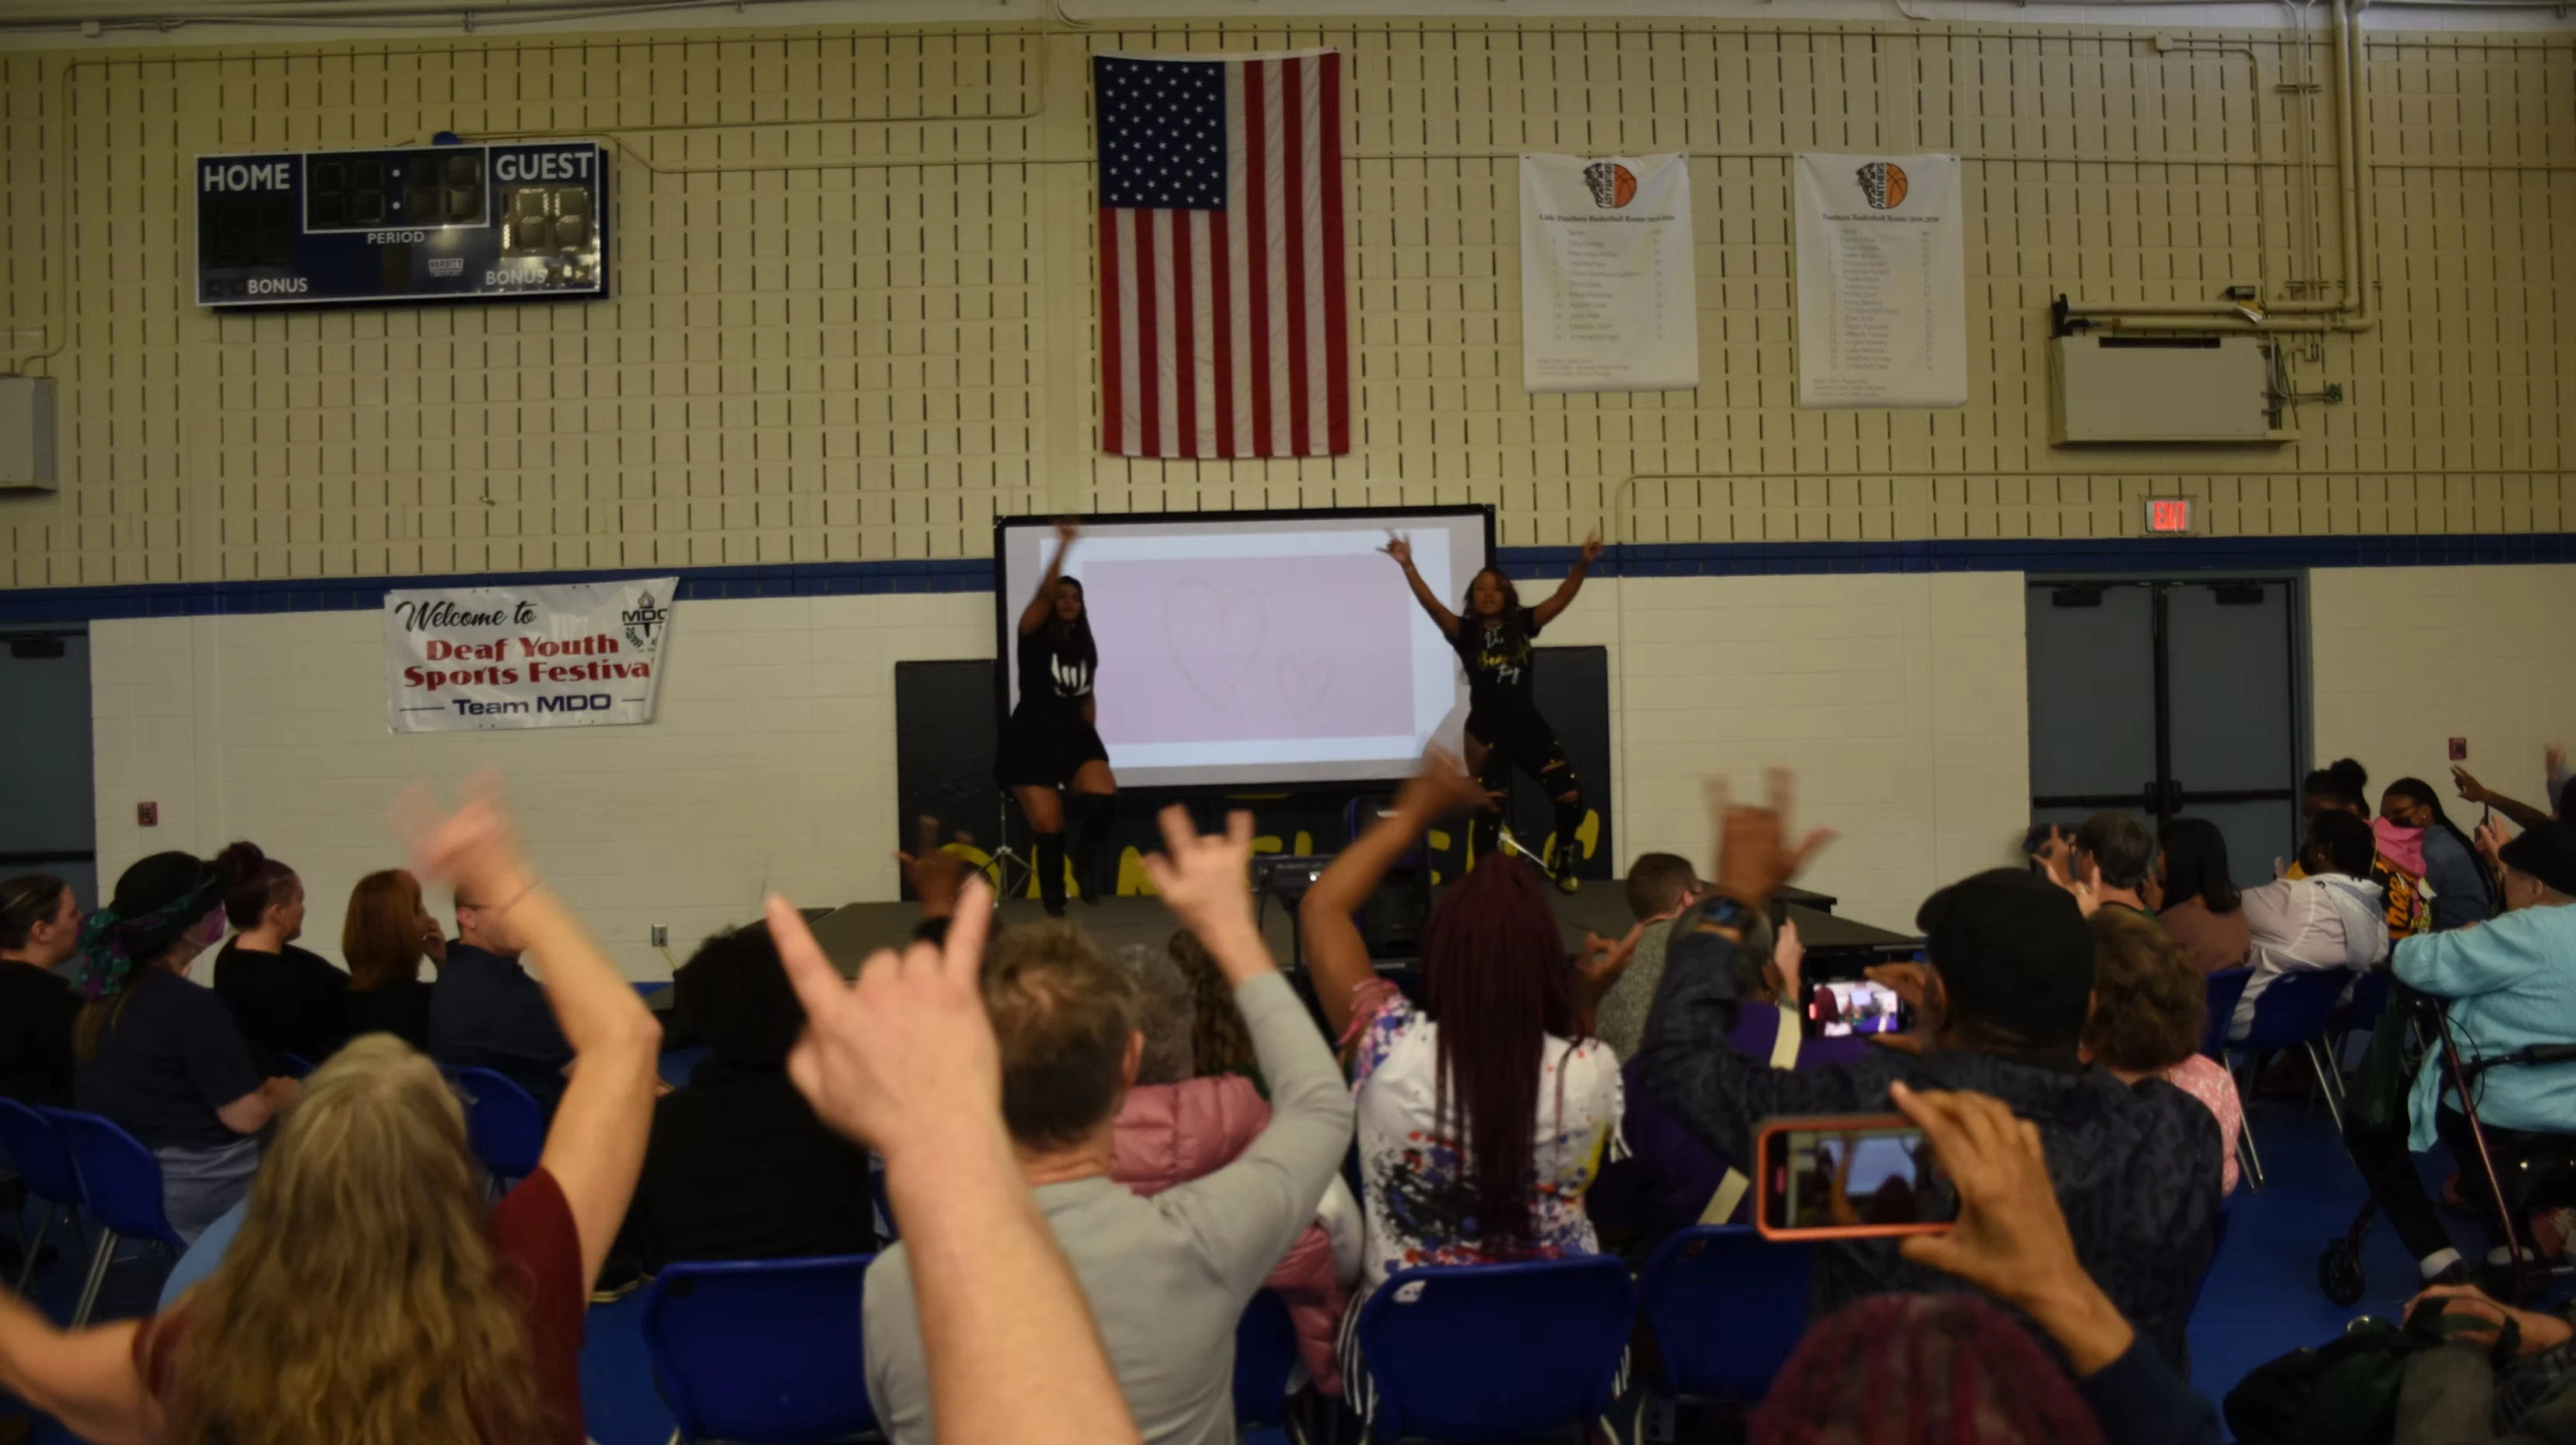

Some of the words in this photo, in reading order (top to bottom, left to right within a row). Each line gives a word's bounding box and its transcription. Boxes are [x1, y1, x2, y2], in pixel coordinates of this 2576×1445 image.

[204, 163, 290, 192] HOME
[496, 152, 593, 181] GUEST
[1876, 162, 1885, 209] PANTHERS
[367, 230, 424, 245] PERIOD
[248, 277, 308, 294] BONUS
[485, 269, 547, 286] BONUS
[2154, 501, 2186, 530] EXIT
[394, 601, 508, 632] Welcome
[514, 600, 537, 624] to
[427, 638, 509, 662] Deaf
[519, 634, 618, 658] Youth
[403, 666, 519, 691] Sports
[529, 657, 654, 683] Festiva
[452, 698, 530, 715] Team
[537, 694, 612, 713] MDO
